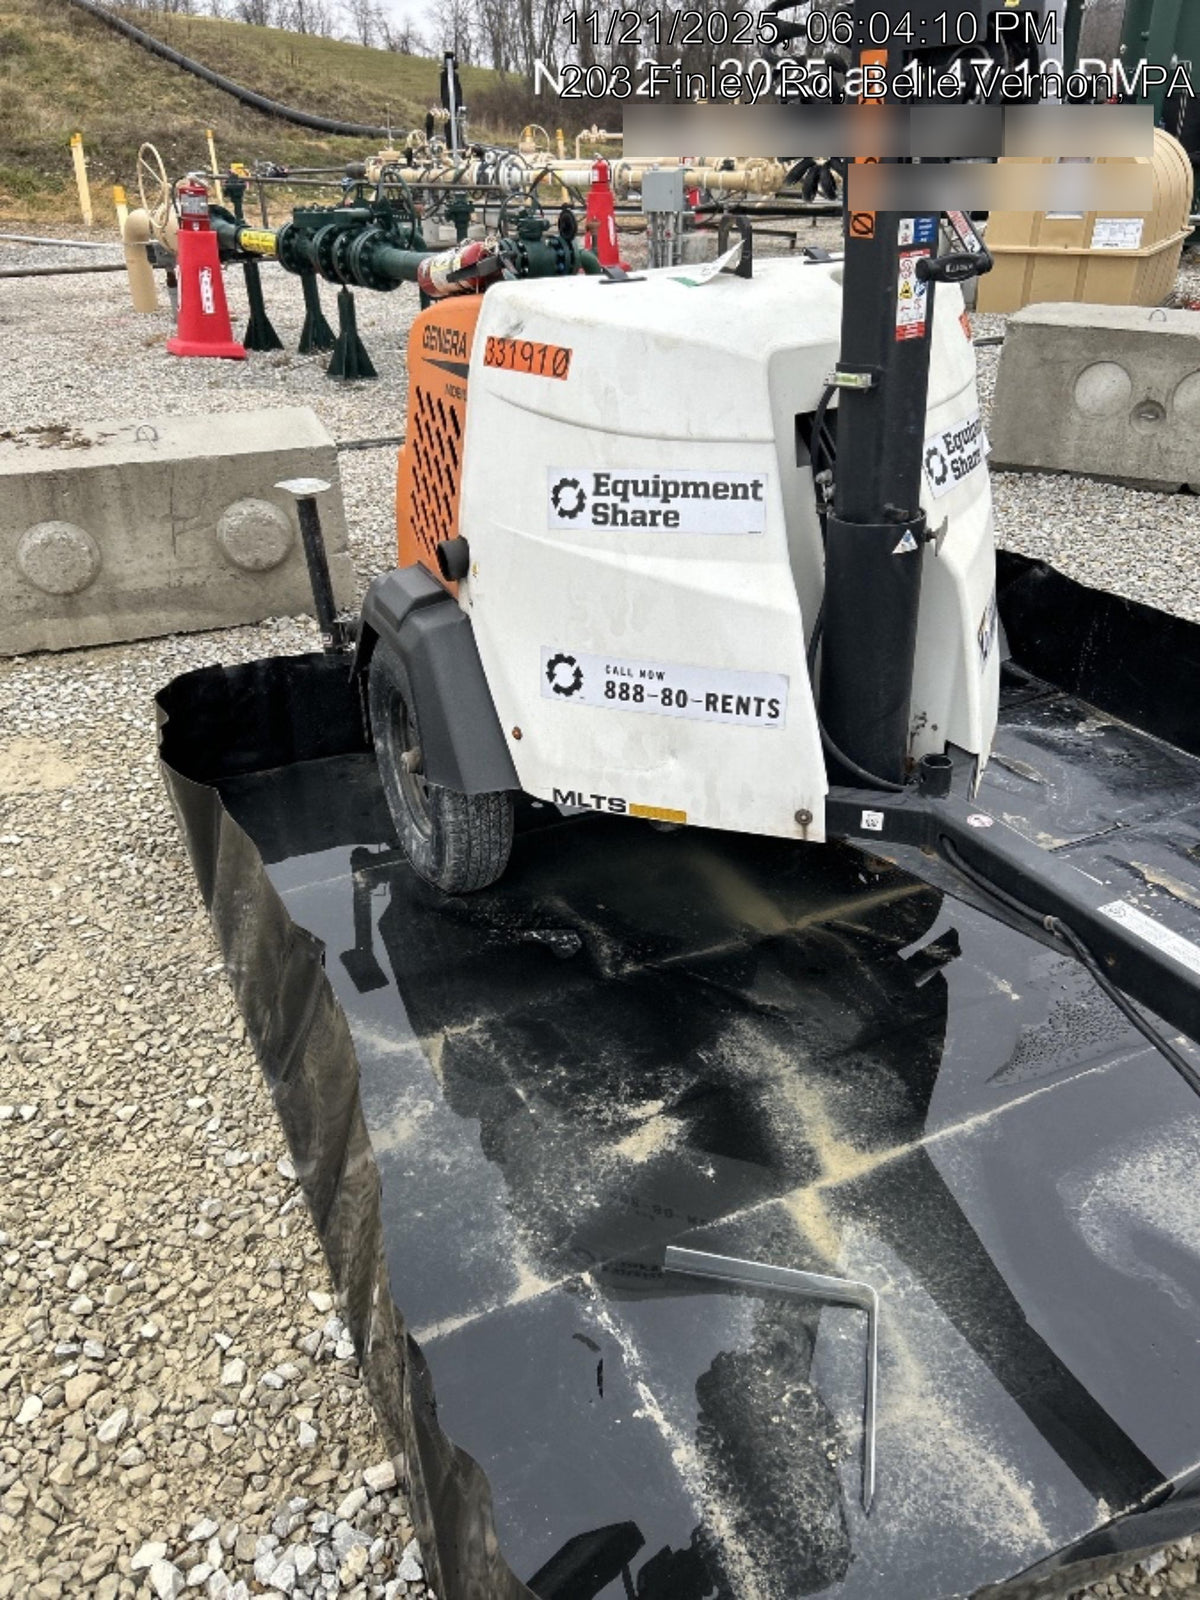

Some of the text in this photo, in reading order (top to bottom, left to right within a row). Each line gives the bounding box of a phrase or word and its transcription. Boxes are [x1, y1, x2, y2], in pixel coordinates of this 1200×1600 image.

[591, 472, 764, 503] Equipment
[591, 503, 681, 529] Share
[605, 664, 666, 681] CALL NOW
[604, 680, 781, 719] 888-80-RENTS
[552, 787, 627, 813] MLTS
